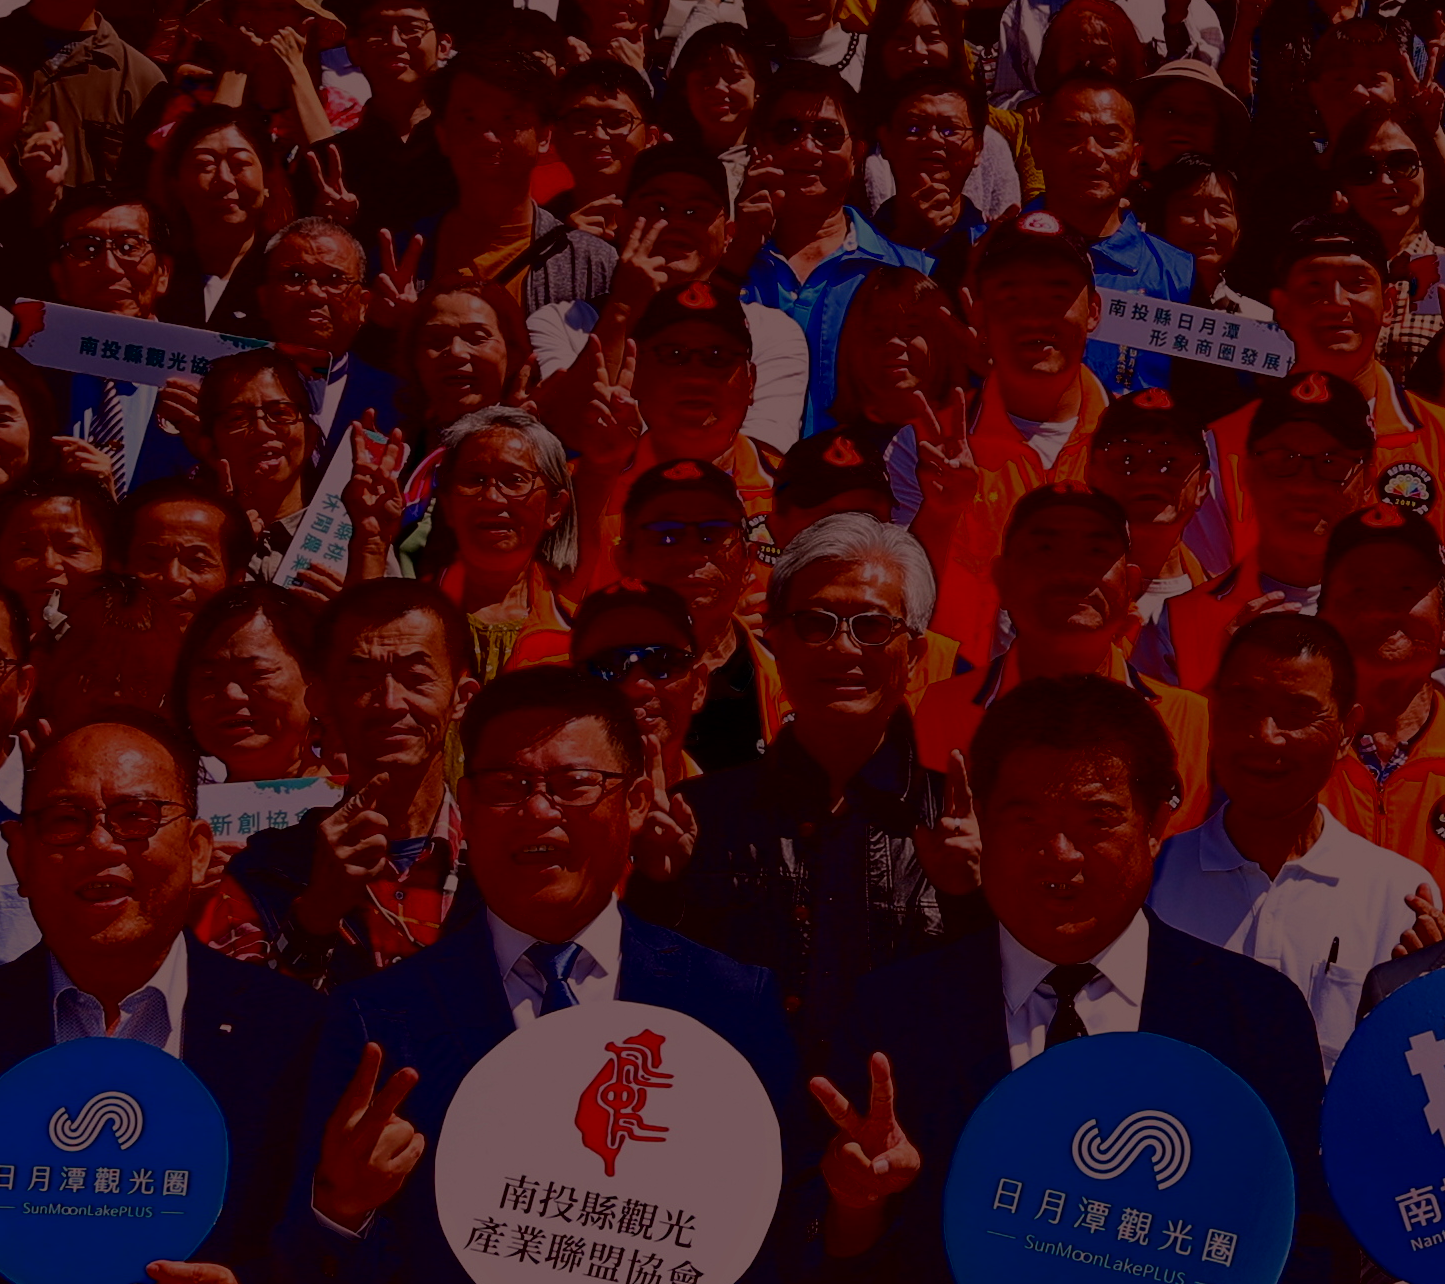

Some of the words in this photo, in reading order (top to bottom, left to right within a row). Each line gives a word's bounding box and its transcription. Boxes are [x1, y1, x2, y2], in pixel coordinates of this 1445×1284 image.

[1108, 298, 1242, 341] 南投縣日月潭
[22, 1201, 154, 1219] SunMoonLakePLUS
[499, 1174, 697, 1250] 南投縣觀光
[992, 1177, 1238, 1268] 日月潭觀光圈
